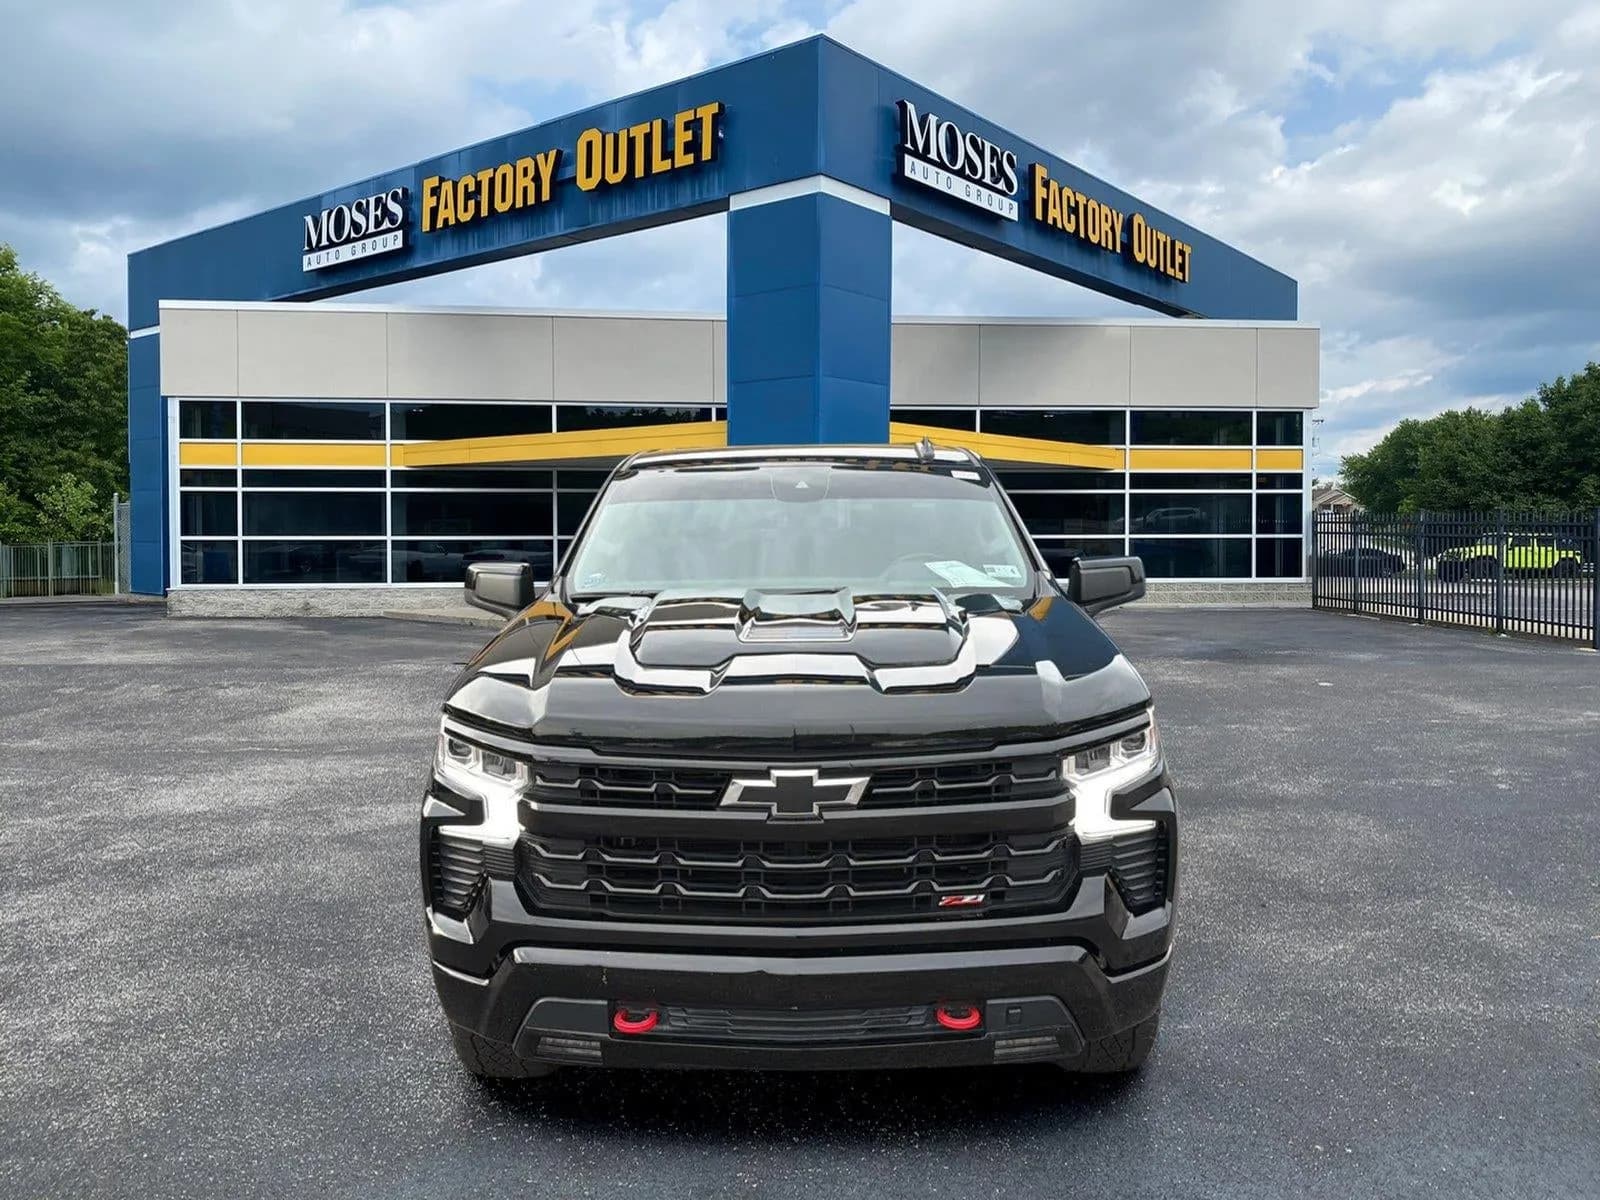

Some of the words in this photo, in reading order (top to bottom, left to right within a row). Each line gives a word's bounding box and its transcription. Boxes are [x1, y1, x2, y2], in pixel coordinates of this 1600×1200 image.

[421, 149, 559, 233] FACTORY
[576, 101, 720, 192] OUTLET
[903, 99, 1018, 196] MOSES
[303, 188, 404, 251] MOSES
[909, 161, 953, 191] AUTO
[965, 187, 1015, 215] GROUP
[1033, 162, 1124, 254] FACTORY
[1132, 211, 1191, 283] OUTLET
[306, 249, 341, 268] AUTO
[350, 234, 399, 256] GROUP
